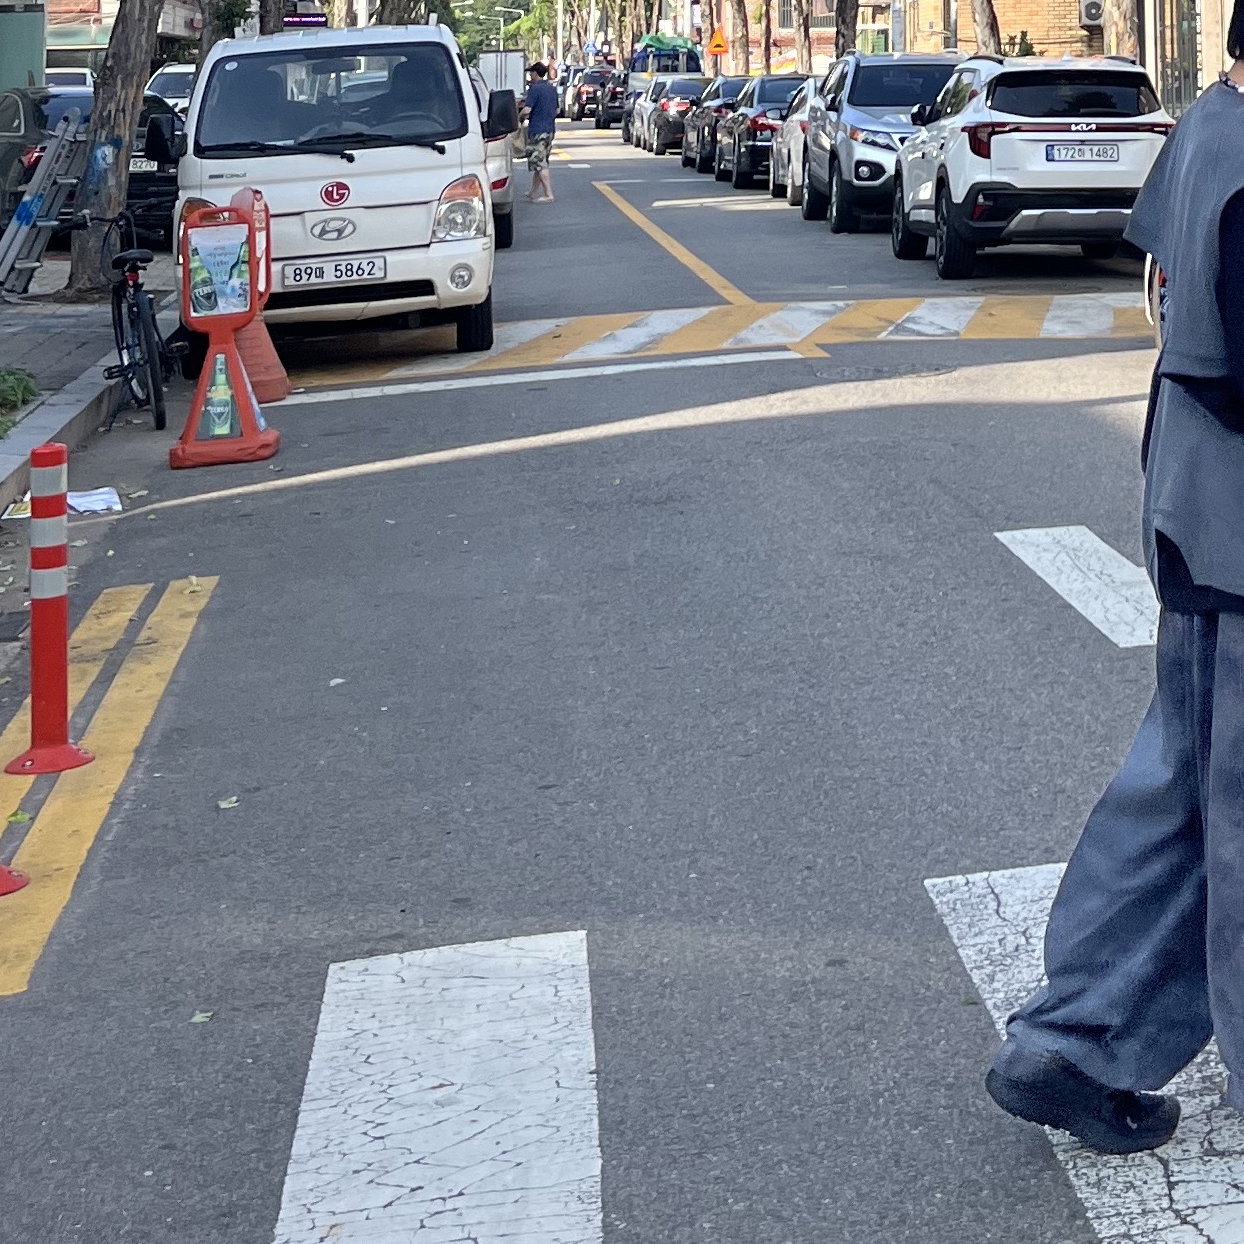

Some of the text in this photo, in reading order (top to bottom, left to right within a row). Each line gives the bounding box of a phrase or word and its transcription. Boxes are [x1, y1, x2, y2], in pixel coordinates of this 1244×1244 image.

[1088, 146, 1115, 159] 1482
[293, 260, 376, 283] 89마 5862
